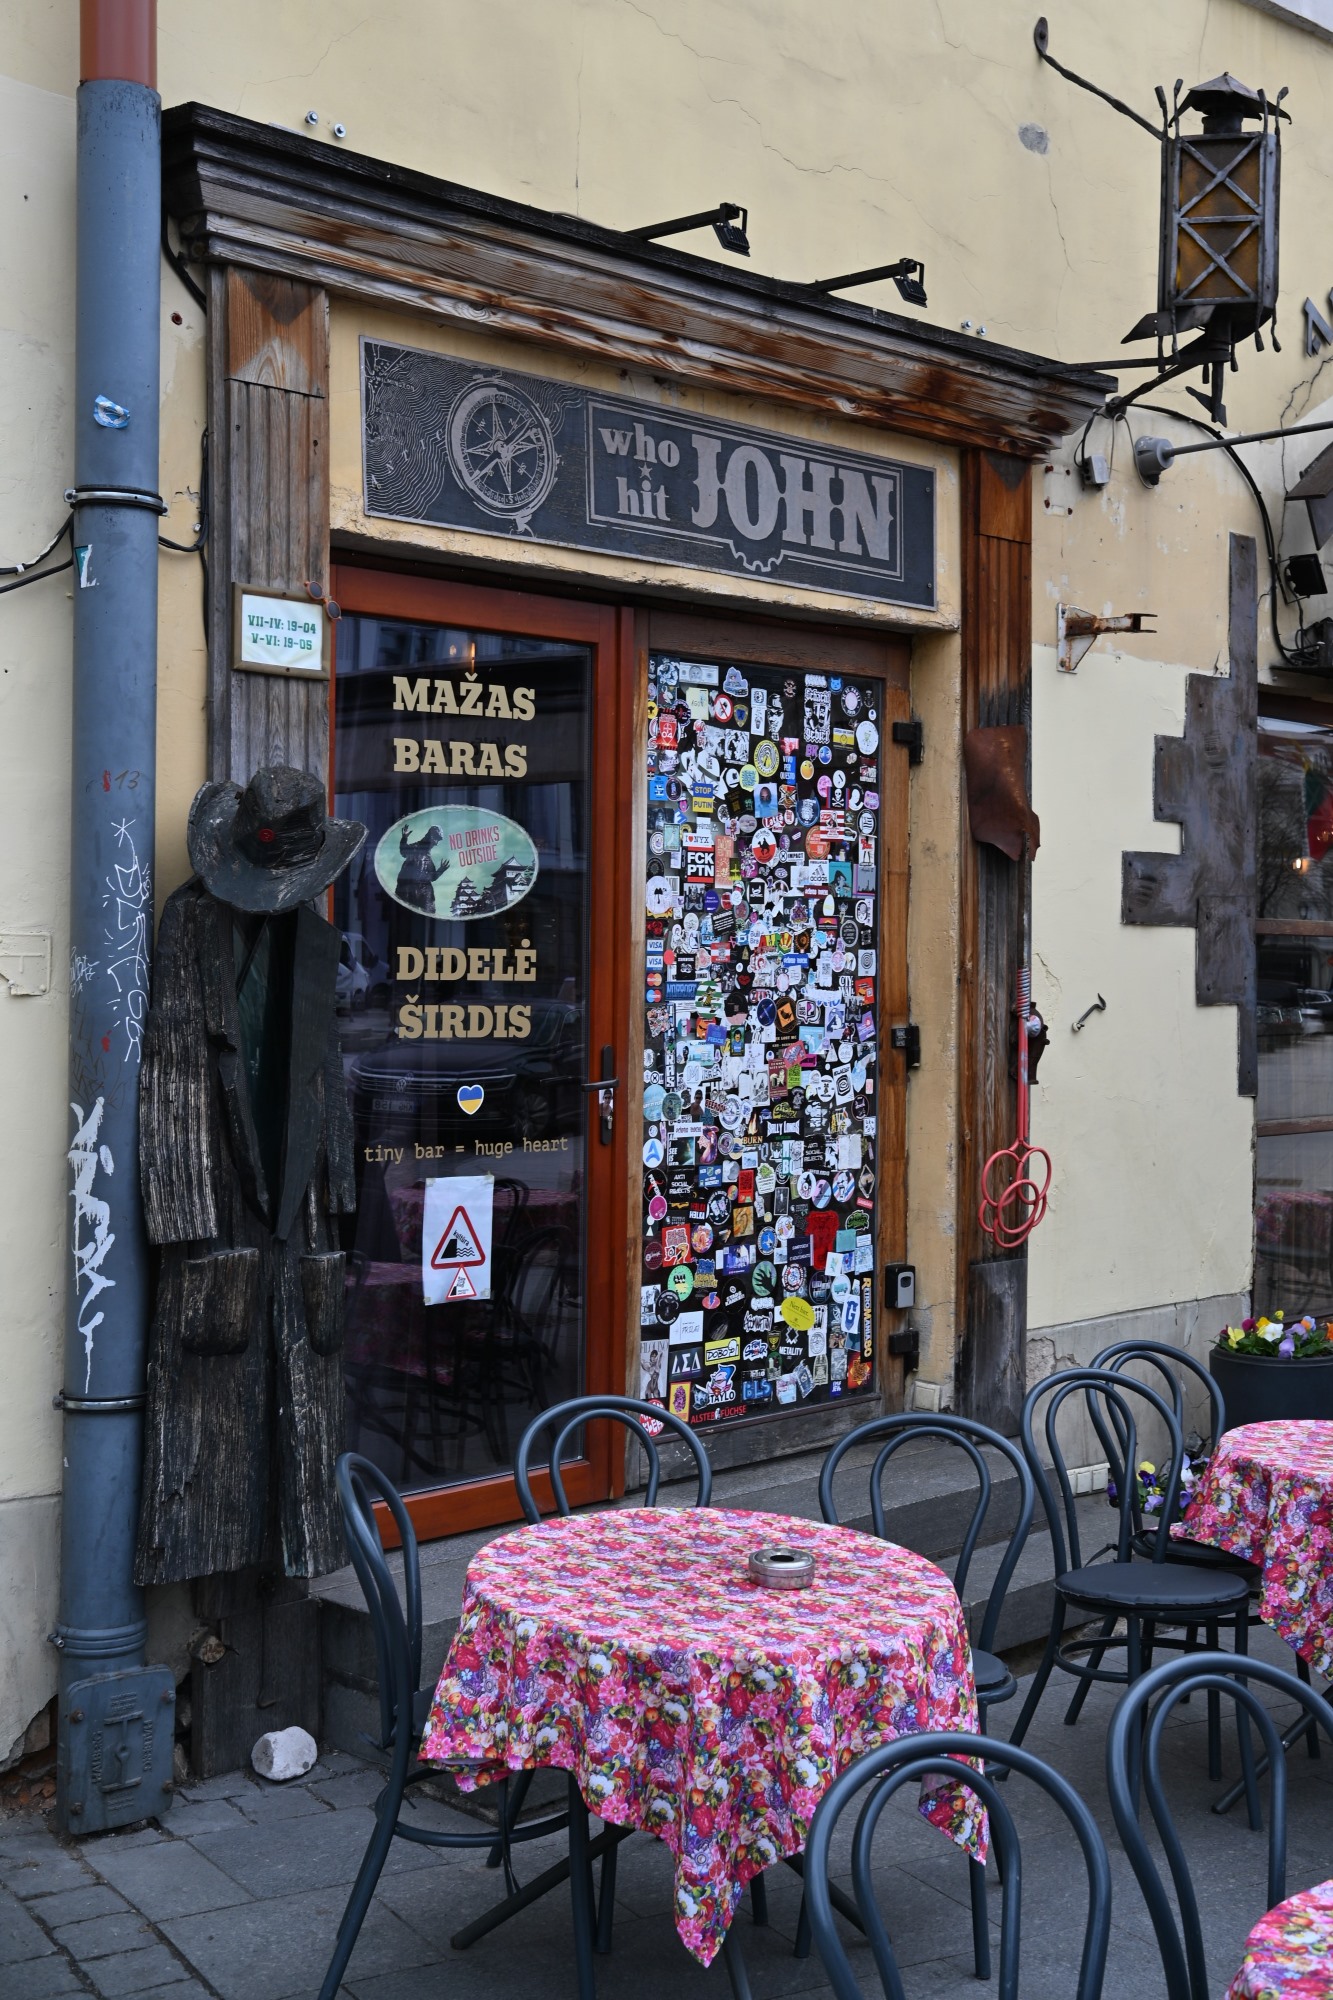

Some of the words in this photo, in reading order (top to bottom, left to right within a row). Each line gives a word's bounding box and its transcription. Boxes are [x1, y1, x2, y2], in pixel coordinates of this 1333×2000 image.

[598, 421, 680, 468] who
[616, 476, 671, 522] hit
[692, 432, 894, 561] JOHN
[248, 614, 284, 630] VII-IV:
[287, 620, 316, 634] 19-04
[251, 633, 280, 646] V-VI:
[284, 636, 312, 650] 19-05
[392, 671, 536, 721] MAŽAS
[393, 737, 528, 778] BARAS
[449, 832, 463, 851] NO
[465, 825, 500, 848] DRINKS
[458, 844, 499, 867] OUTSIDE
[687, 852, 714, 864] FCK
[687, 864, 714, 877] PTN
[649, 941, 662, 949] VISA
[396, 938, 538, 982] DIDELĖ
[397, 994, 532, 1039] ŠIRDIS
[364, 1145, 404, 1164] tiny
[415, 1142, 445, 1159] bar
[475, 1140, 513, 1160] huge
[522, 1136, 569, 1153] heart
[743, 1136, 763, 1144] BURN
[720, 1405, 747, 1417] FÜCHSE
